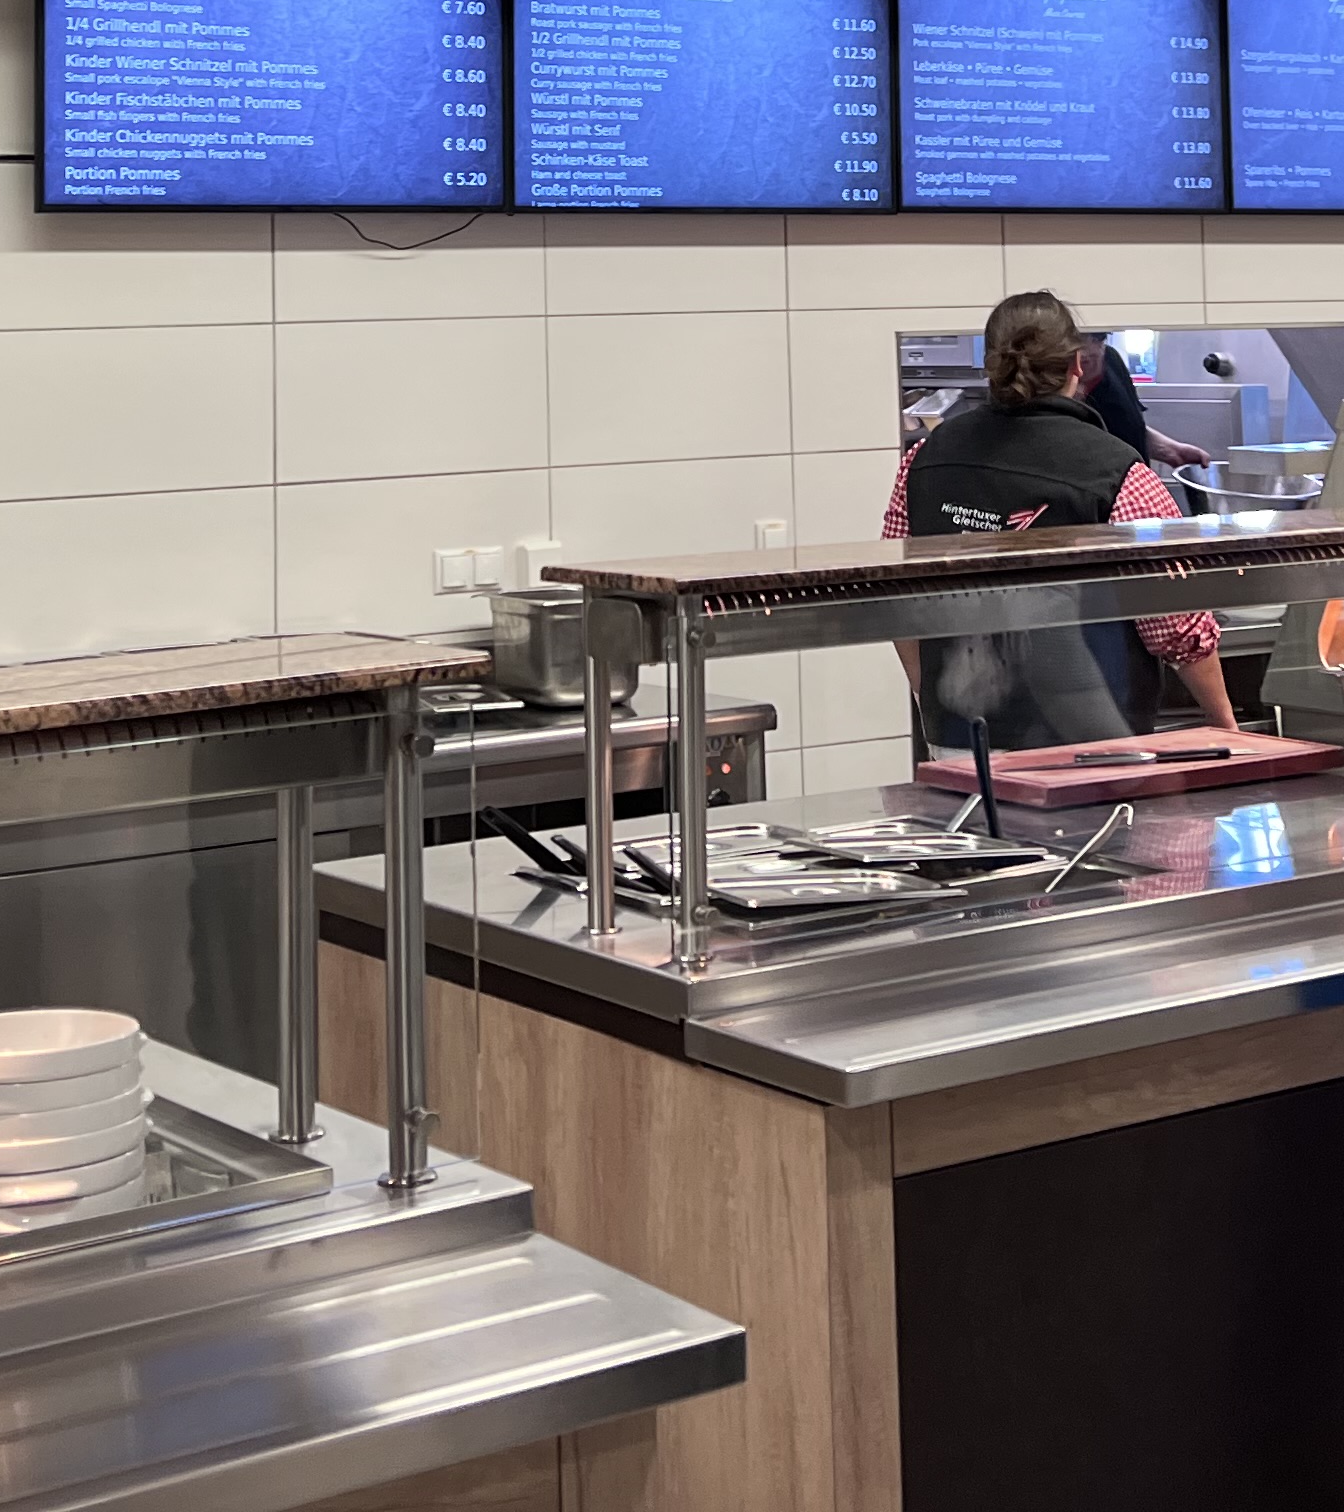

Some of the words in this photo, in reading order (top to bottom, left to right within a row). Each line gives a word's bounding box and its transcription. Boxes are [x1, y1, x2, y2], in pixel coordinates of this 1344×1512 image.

[442, 0, 452, 14] €
[455, 1, 486, 15] 7.60
[530, 0, 588, 16] Bratwurst
[590, 4, 610, 17] mit
[612, 5, 661, 19] Pommes
[65, 16, 89, 31] 1/4
[93, 18, 162, 34] Grillhendl
[165, 20, 188, 35] mit
[192, 22, 250, 37] Pommes
[832, 18, 841, 31] €
[843, 19, 877, 32] 11.60
[442, 35, 452, 48] €
[455, 35, 486, 49] 8.40
[531, 31, 551, 45] 1/2
[553, 32, 609, 47] Grillhendl
[611, 35, 631, 48] mit
[633, 36, 682, 50] Pommes
[833, 47, 841, 59] €
[844, 47, 877, 60] 12.50
[65, 54, 113, 69] Kinder
[116, 55, 166, 70] Wiener
[169, 57, 232, 73] Schnitzel
[235, 59, 258, 73] mit
[261, 61, 319, 76] Pommes
[530, 61, 596, 77] Currywurst
[597, 64, 618, 77] mit
[619, 65, 669, 79] Pommes
[442, 69, 452, 82] €
[455, 69, 486, 83] 8.60
[833, 75, 841, 87] €
[844, 75, 877, 88] 12.70
[65, 91, 113, 106] Kinder
[116, 92, 214, 108] Fischstäbchen
[218, 94, 241, 108] mit
[244, 96, 302, 110] Pommes
[530, 91, 569, 105] Würstl
[571, 93, 592, 106] mit
[594, 94, 643, 107] Pommes
[442, 103, 453, 117] €
[456, 103, 487, 117] 8.40
[833, 103, 841, 116] €
[844, 103, 877, 117] 10.50
[530, 122, 569, 135] Würstl
[571, 123, 592, 136] mit
[594, 123, 622, 137] Senf
[65, 128, 113, 143] Kinder
[116, 129, 227, 147] Chickennuggets
[231, 131, 254, 145] mit
[257, 132, 314, 146] Pommes
[442, 137, 453, 151] €
[456, 138, 487, 152] 8.40
[841, 131, 849, 144] €
[851, 132, 878, 145] 5.50
[530, 152, 617, 166] Schinken-Käse
[618, 154, 650, 167] Toast
[834, 160, 843, 173] €
[845, 160, 878, 173] 11.90
[65, 166, 116, 180] Portion
[120, 166, 181, 181] Pommes
[443, 172, 453, 186] €
[456, 172, 487, 186] 5.20
[530, 183, 568, 197] Große
[570, 184, 612, 197] Portion
[614, 184, 663, 197] Pommes
[841, 189, 850, 201] €
[852, 189, 879, 202] 8.10
[941, 502, 1002, 523] Hintertuxer
[952, 514, 1002, 533] Gletscher
